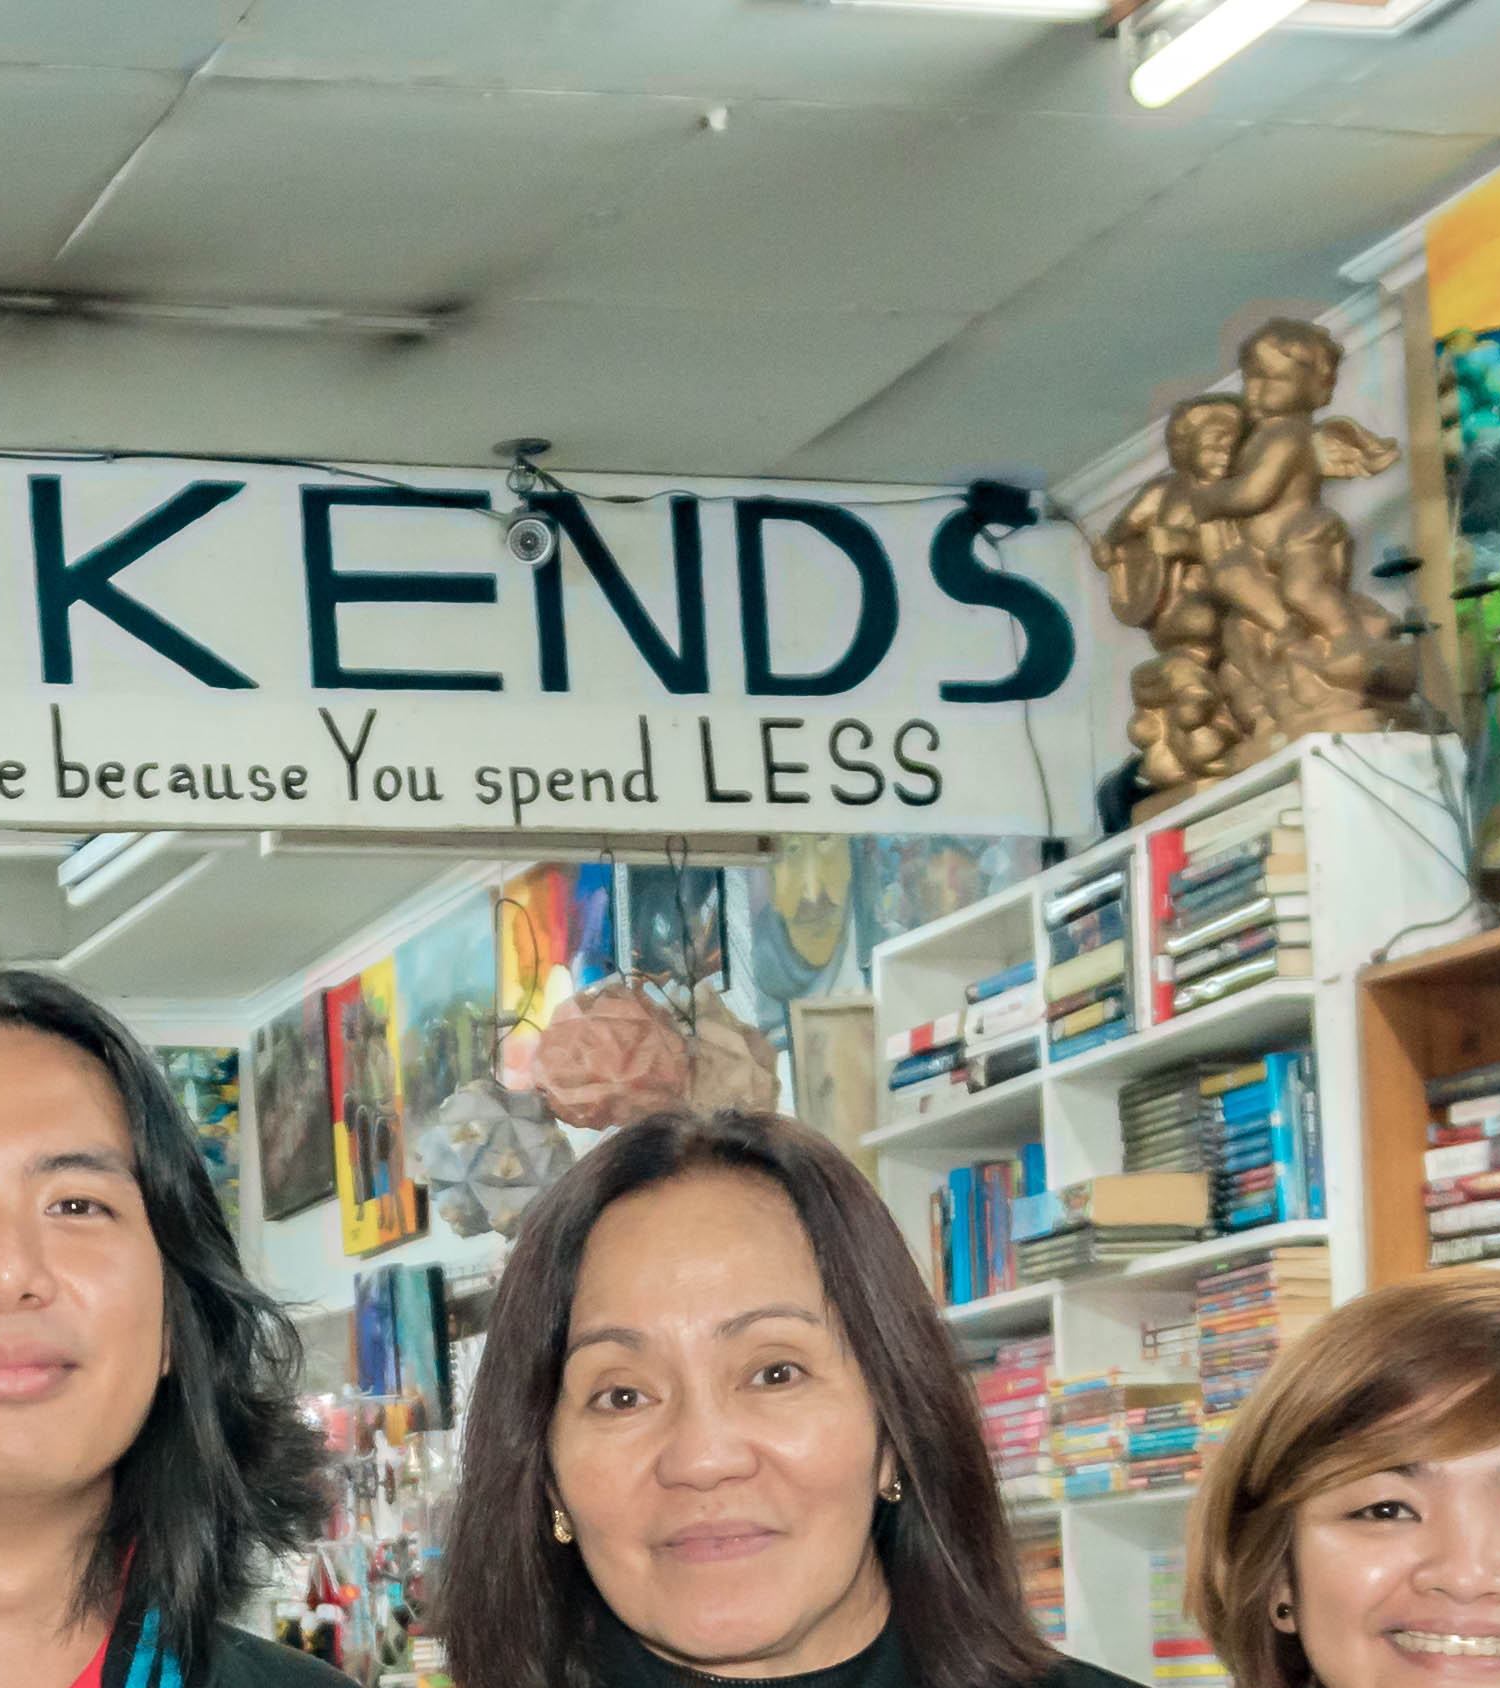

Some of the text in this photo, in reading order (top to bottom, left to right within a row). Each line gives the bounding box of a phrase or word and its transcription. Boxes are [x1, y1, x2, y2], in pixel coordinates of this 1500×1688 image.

[50, 703, 308, 801] because
[319, 707, 444, 803] You
[475, 714, 659, 826] spend
[700, 716, 943, 806] LESS
